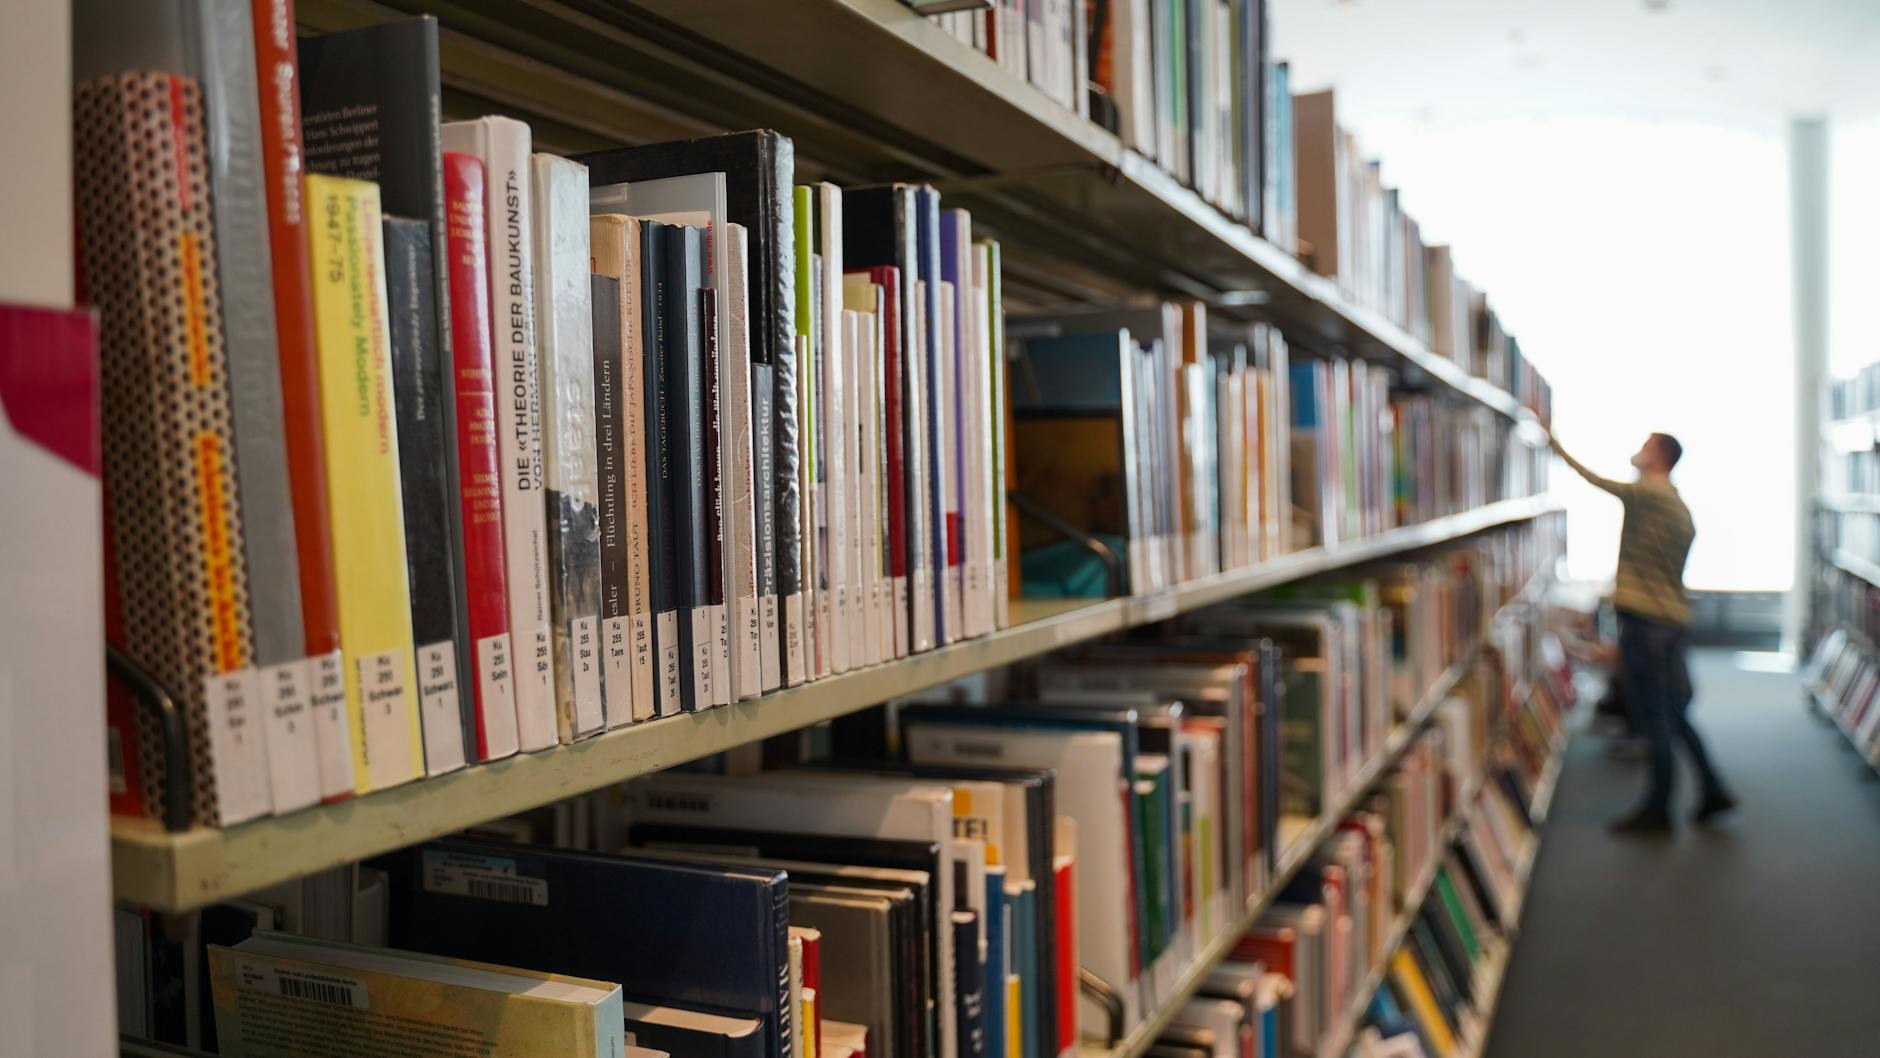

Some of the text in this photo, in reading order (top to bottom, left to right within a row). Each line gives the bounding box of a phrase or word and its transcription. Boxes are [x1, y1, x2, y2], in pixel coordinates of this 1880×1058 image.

[345, 195, 373, 416] Passionately Modern
[506, 169, 531, 491] DIE «THEORIE DER BAUKUNST»
[657, 315, 665, 342] Band
[658, 343, 666, 382] Zweiter
[527, 352, 541, 443] HERMAN
[601, 359, 612, 419] Ländern
[375, 375, 391, 455] modern
[659, 389, 667, 454] TAGEBUCH
[603, 423, 613, 452] drei
[532, 447, 542, 490] VON
[604, 456, 613, 471] in
[660, 455, 668, 480] DAS
[604, 474, 617, 548] Flüchtling
[761, 397, 772, 597] Präzisionsarchitektur
[631, 519, 641, 561] TAUT
[632, 563, 642, 615] BRUNO
[536, 632, 547, 644] Ku
[579, 620, 589, 632] Ku
[579, 633, 591, 646] 255
[611, 621, 622, 632] Ku
[611, 634, 623, 645] 255
[493, 639, 504, 651] Ku
[536, 645, 548, 659] 255
[610, 648, 625, 659] Taes
